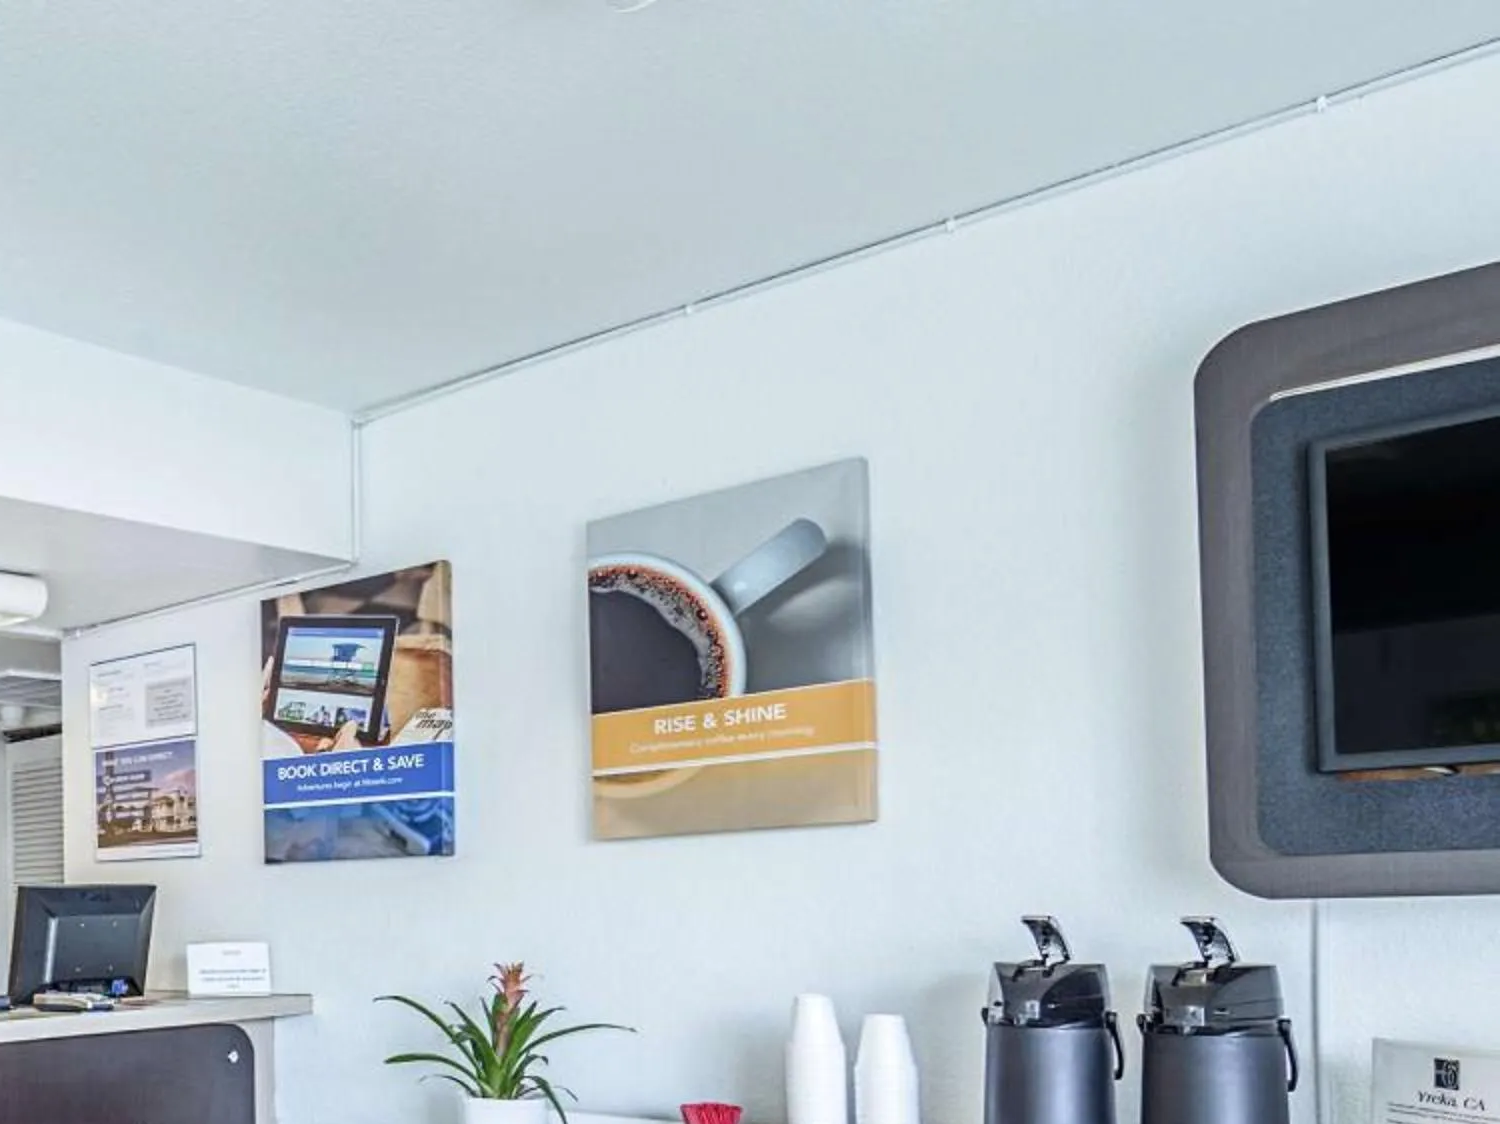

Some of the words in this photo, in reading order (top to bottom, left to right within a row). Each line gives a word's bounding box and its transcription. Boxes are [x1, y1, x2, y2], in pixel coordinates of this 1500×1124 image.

[654, 715, 696, 735] RISE
[703, 713, 717, 729] &
[724, 703, 788, 726] SHINE
[277, 766, 317, 781] BOOK
[320, 759, 368, 776] DIRECT
[373, 757, 384, 771] &
[388, 753, 425, 770] SAVE
[1463, 1097, 1485, 1111] CA
